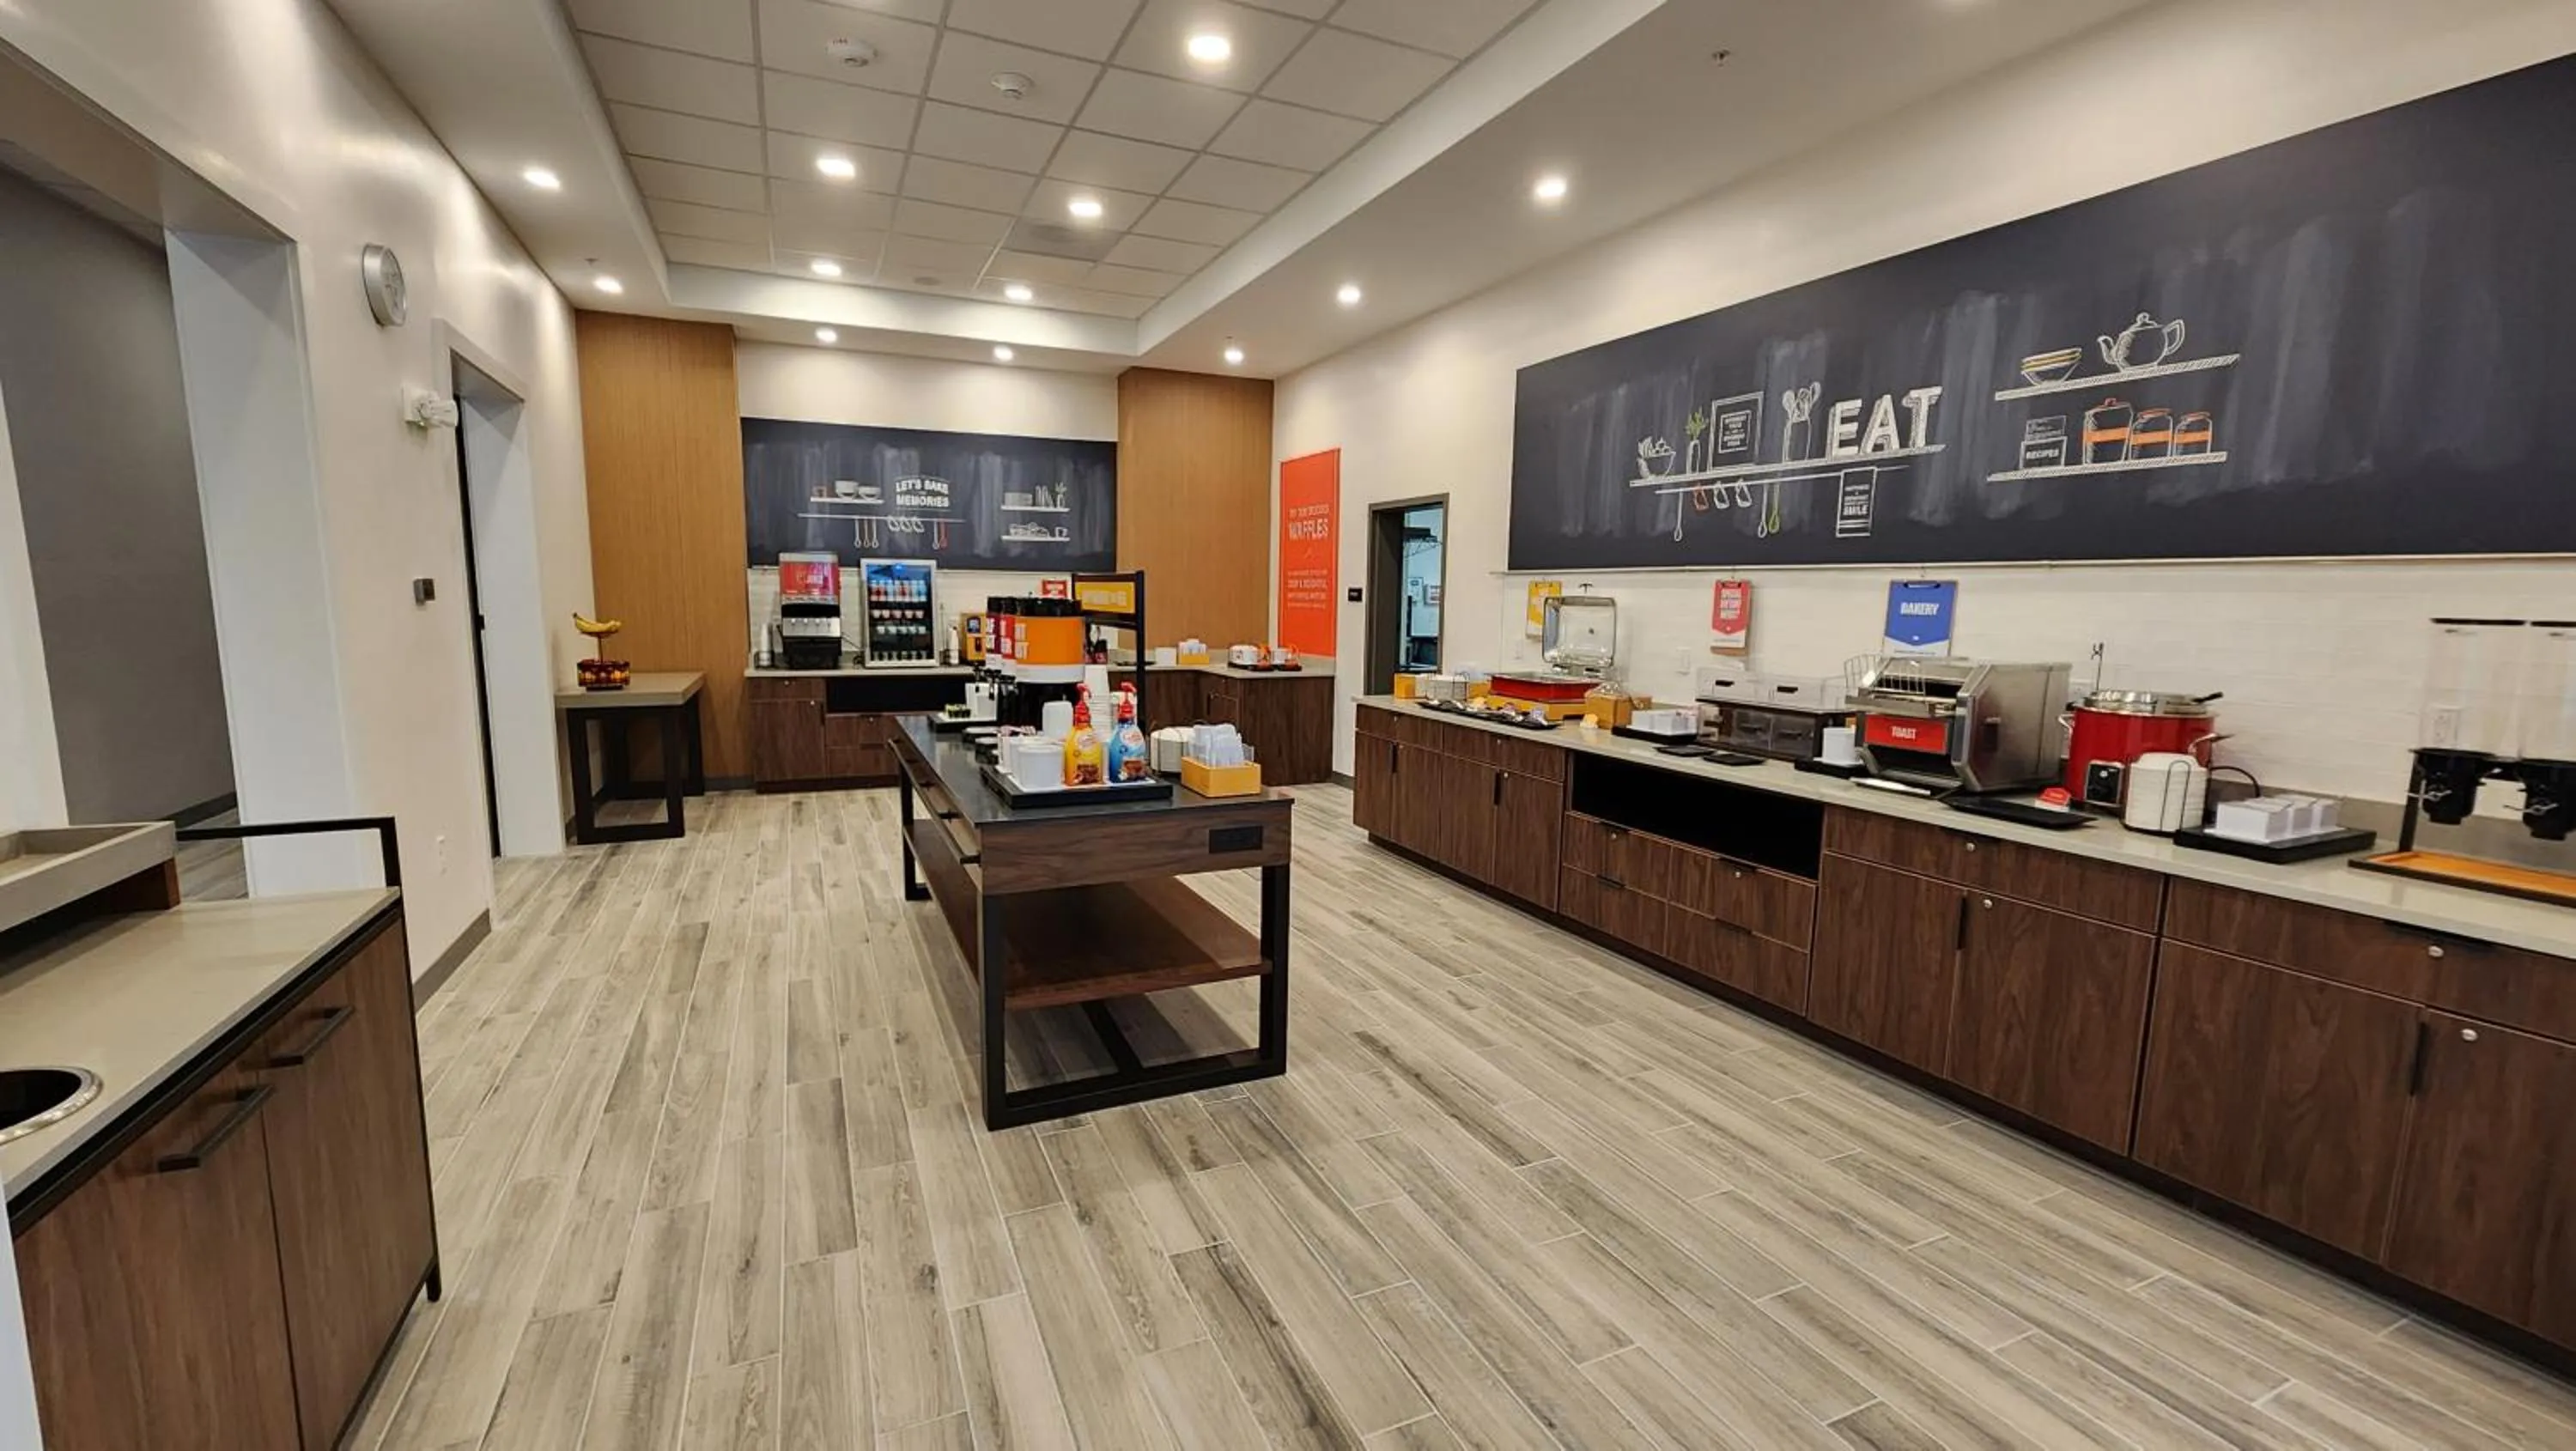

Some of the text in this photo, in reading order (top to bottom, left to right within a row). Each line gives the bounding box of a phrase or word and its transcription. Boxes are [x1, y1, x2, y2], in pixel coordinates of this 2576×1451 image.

[1826, 386, 1943, 461] EAT
[896, 479, 949, 495] LET'S BAKE
[896, 494, 949, 507] MEMORIES
[1289, 518, 1328, 540] WAFFLES
[1900, 602, 1940, 616] BAKERY
[1892, 726, 1917, 740] TOAST
